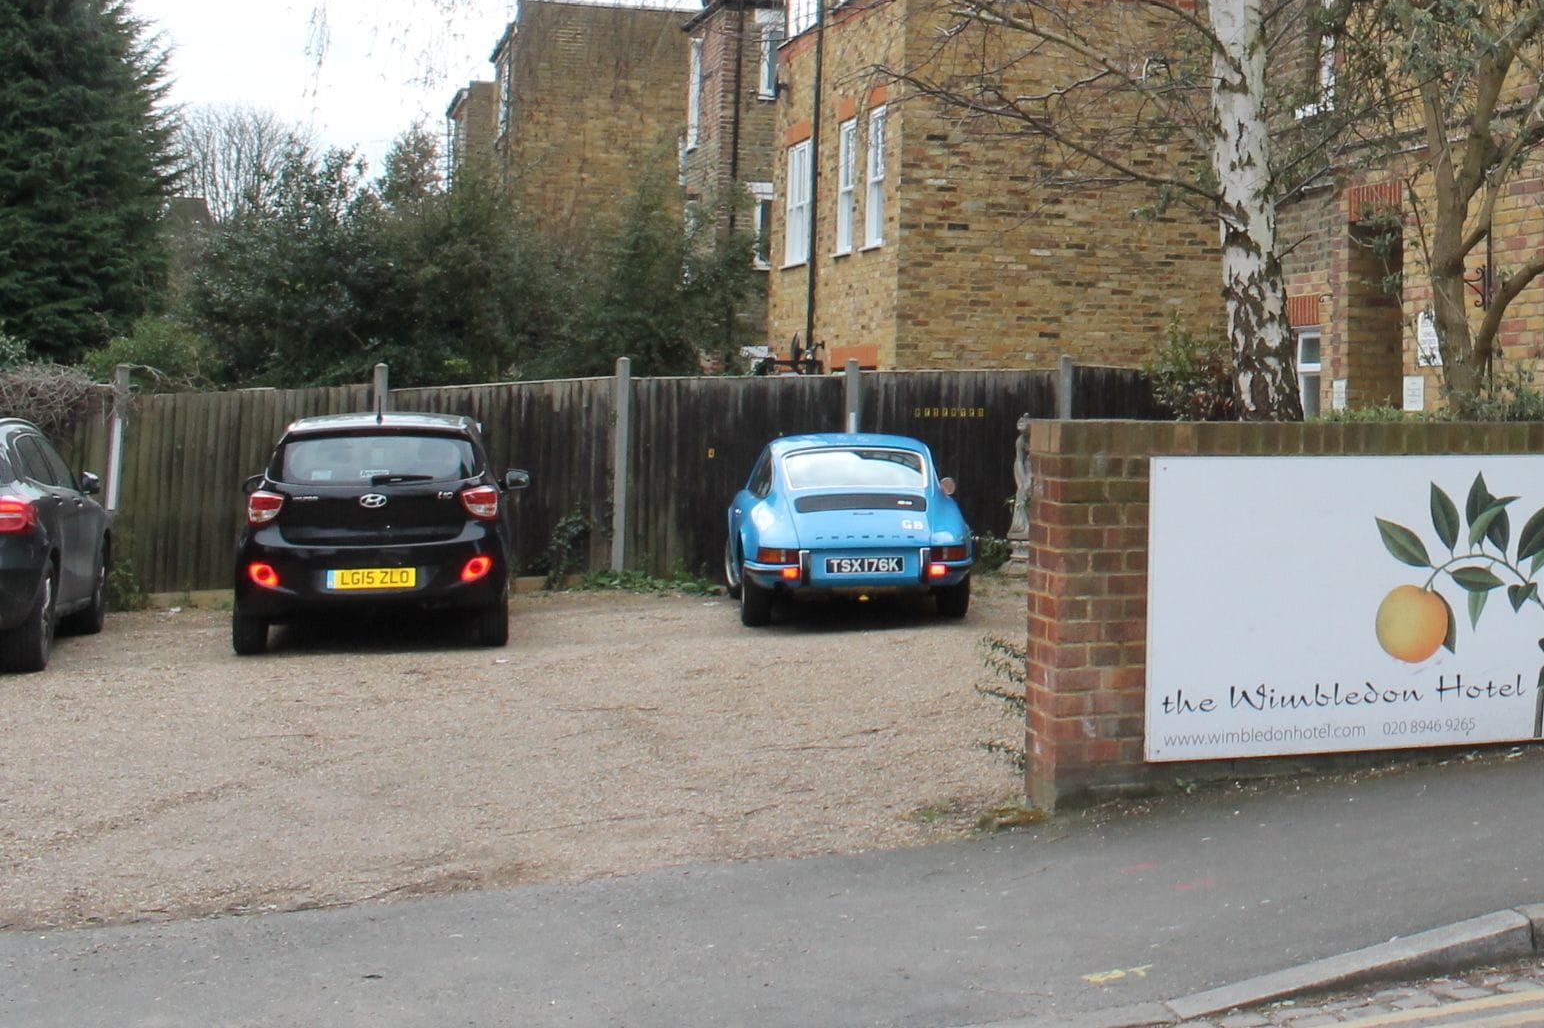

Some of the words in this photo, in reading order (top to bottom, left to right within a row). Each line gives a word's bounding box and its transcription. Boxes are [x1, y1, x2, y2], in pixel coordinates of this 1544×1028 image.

[902, 519, 924, 530] GB
[340, 571, 376, 586] LG15
[379, 570, 410, 585] ZLO
[1162, 689, 1217, 715] the
[1230, 682, 1424, 711] Wimbledon
[1435, 674, 1526, 703] Hotel
[1163, 724, 1366, 747] www.wimbledonhotel.com
[1382, 721, 1407, 736] 020
[1410, 719, 1442, 734] 8946
[1445, 717, 1476, 732] 9265
